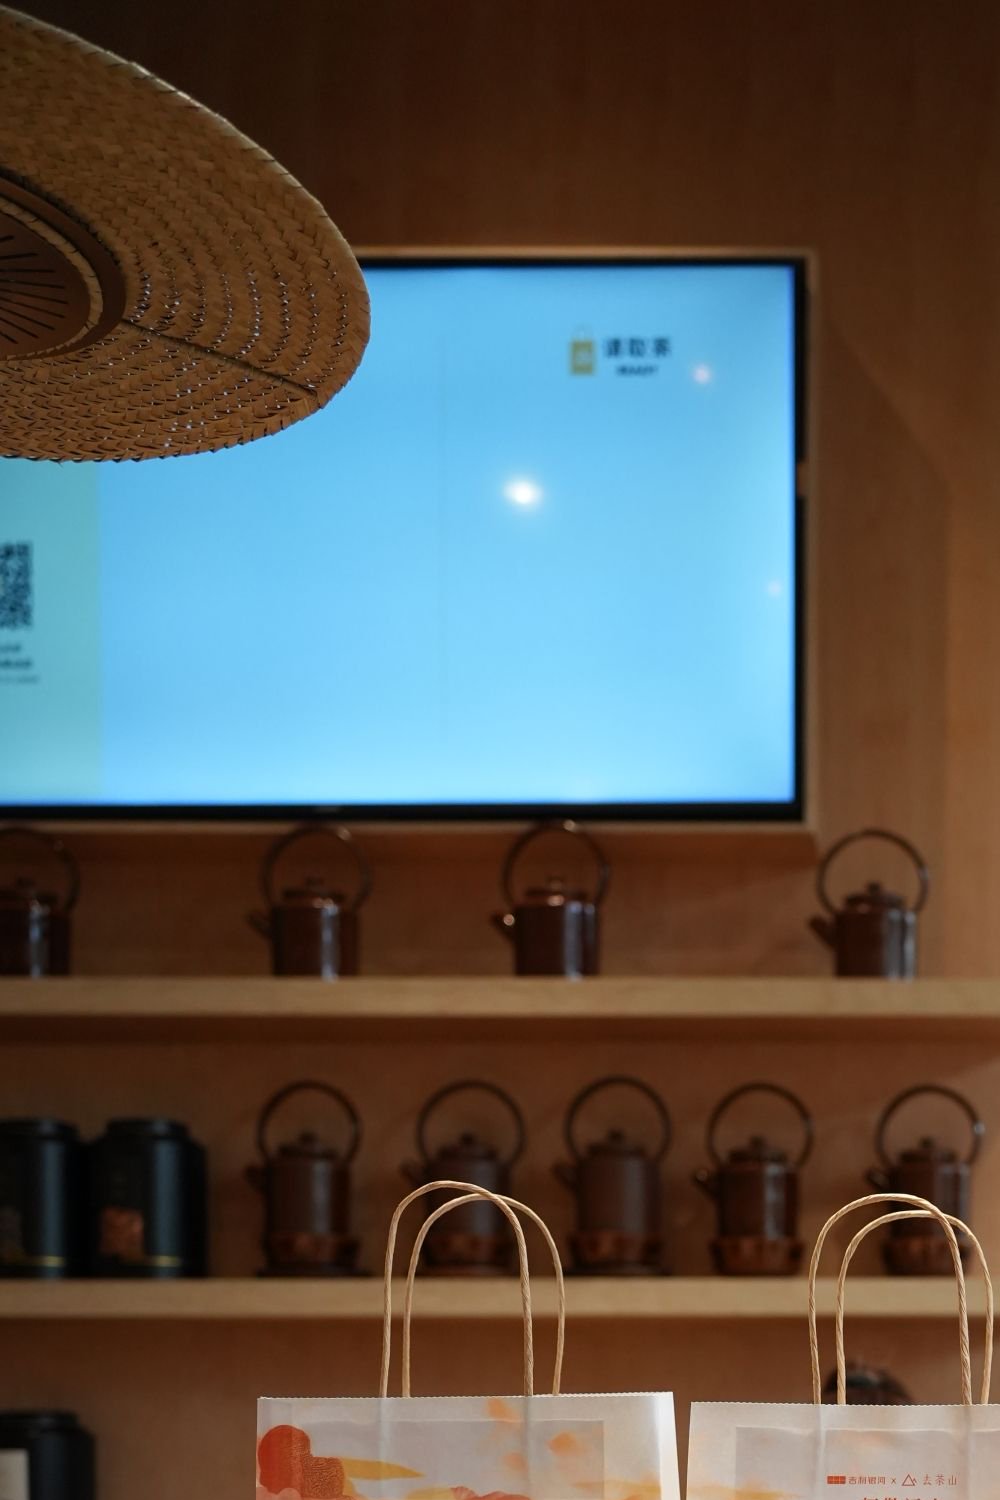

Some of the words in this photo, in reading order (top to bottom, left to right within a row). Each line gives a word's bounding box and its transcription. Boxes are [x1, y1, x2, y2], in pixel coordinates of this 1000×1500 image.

[848, 1475, 886, 1485] 吉利银河
[923, 1474, 958, 1486] 去茶山
